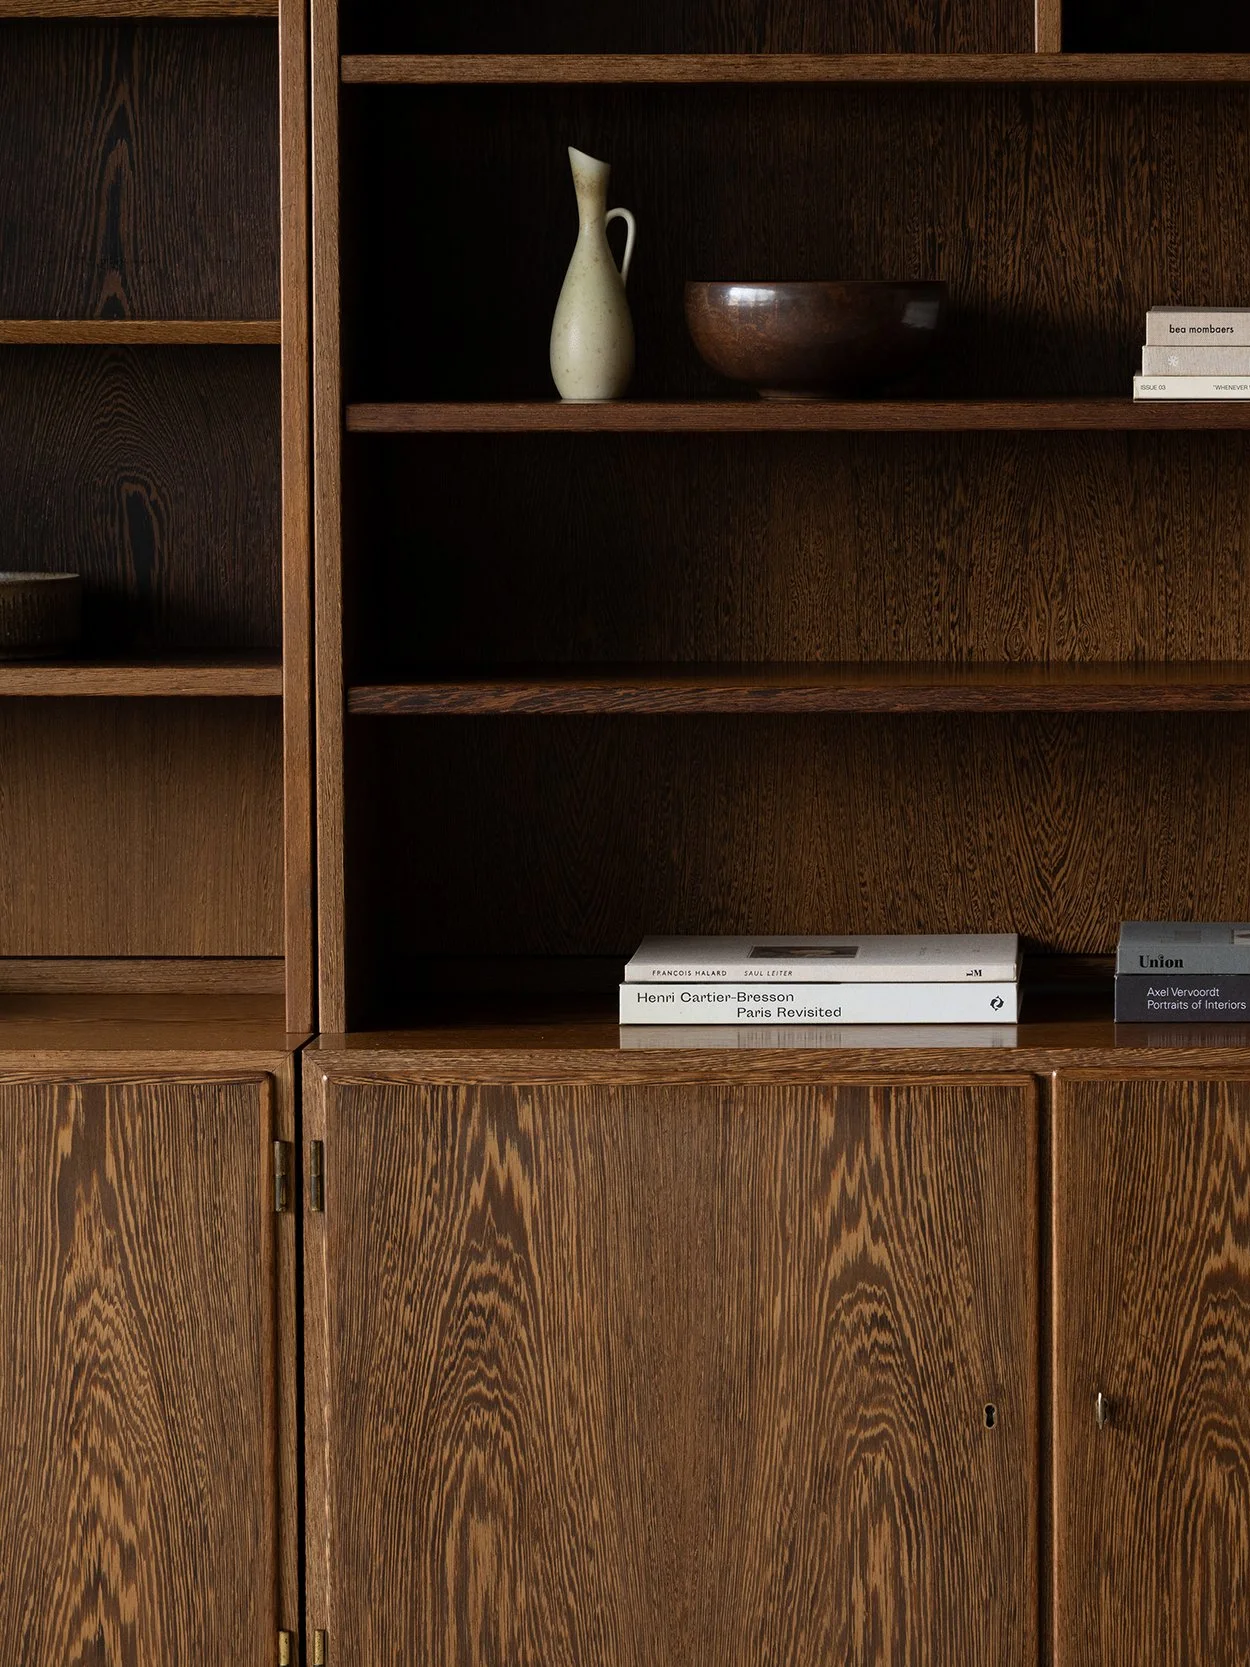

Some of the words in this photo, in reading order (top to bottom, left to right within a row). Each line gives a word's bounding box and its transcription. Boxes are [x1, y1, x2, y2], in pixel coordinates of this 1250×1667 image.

[1169, 324, 1187, 334] bea
[1188, 324, 1235, 334] mombaers
[1139, 954, 1184, 968] Union
[1147, 987, 1169, 997] Axel
[1171, 987, 1220, 997] Vervoordt
[637, 992, 675, 1003] Henri
[680, 992, 794, 1003] Cartier-Bresson
[1147, 1000, 1189, 1010] Portraits
[1191, 1000, 1202, 1010] of
[1205, 1000, 1247, 1010] Interiors
[737, 1007, 772, 1018] Paris
[777, 1007, 842, 1018] Revisited
